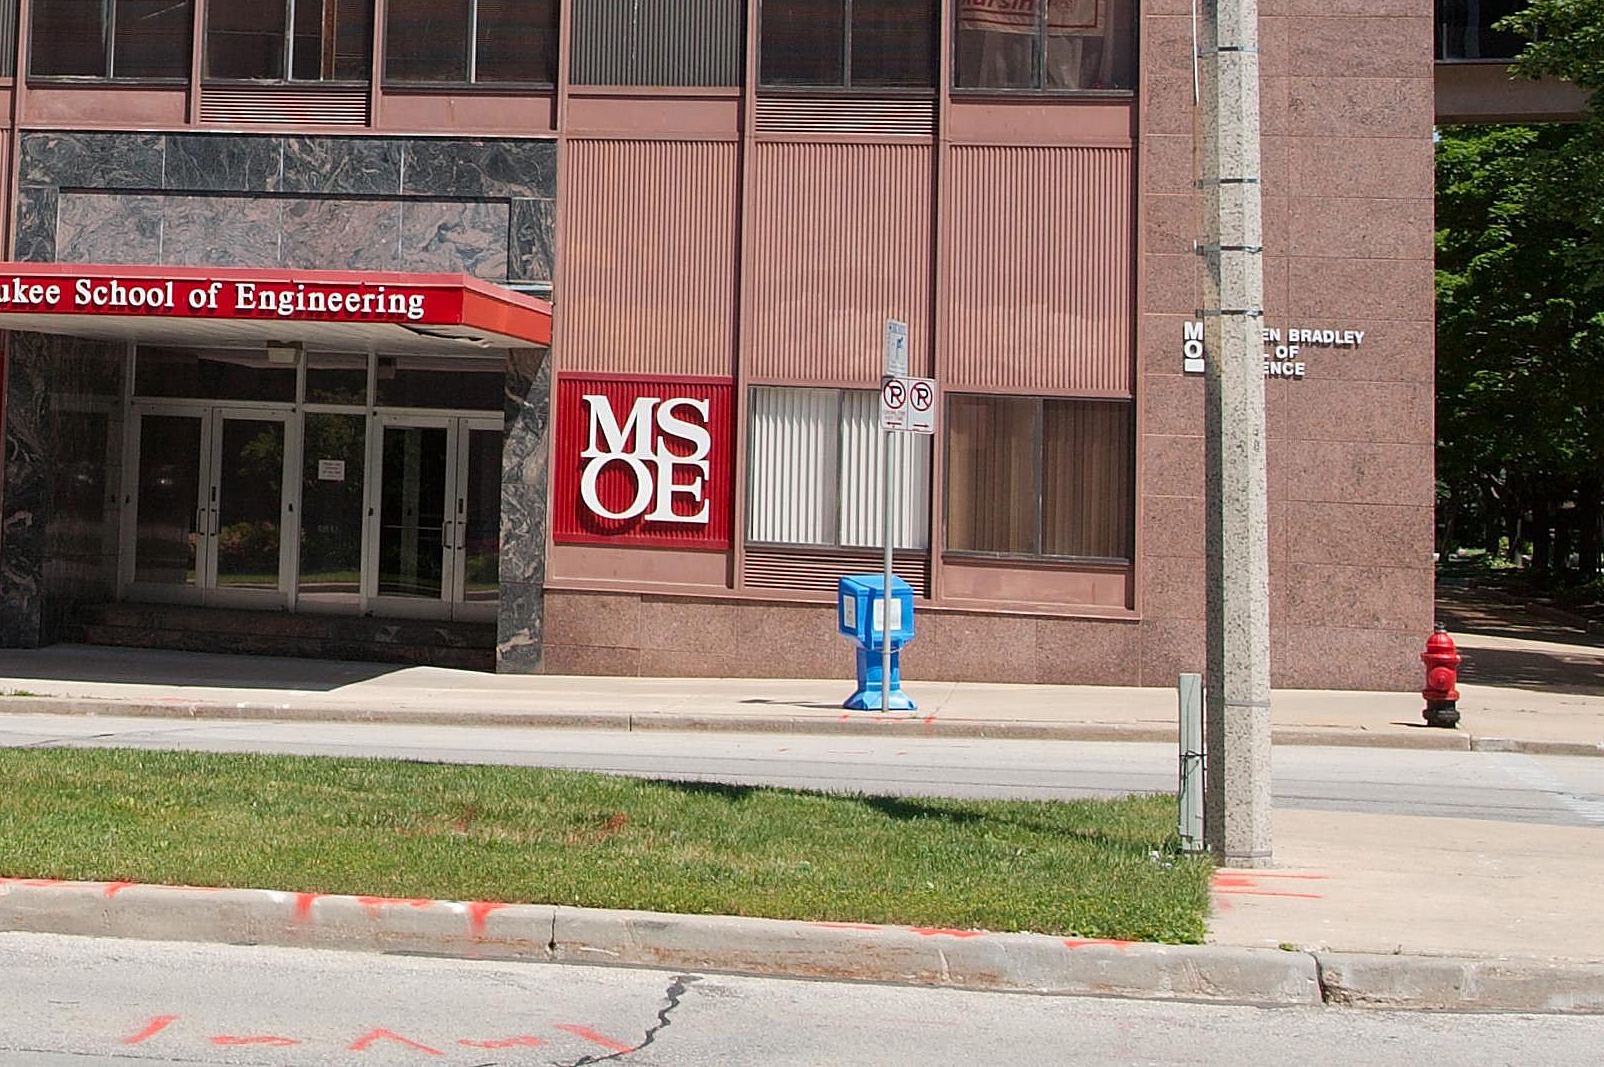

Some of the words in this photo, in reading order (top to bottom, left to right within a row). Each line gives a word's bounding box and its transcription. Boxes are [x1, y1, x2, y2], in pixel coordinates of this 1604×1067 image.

[75, 278, 174, 308] School
[188, 282, 223, 309] of
[235, 282, 425, 319] Engineering
[1288, 328, 1365, 344] BRADLEY
[1275, 345, 1300, 359] OF
[1263, 362, 1306, 376] ENCE
